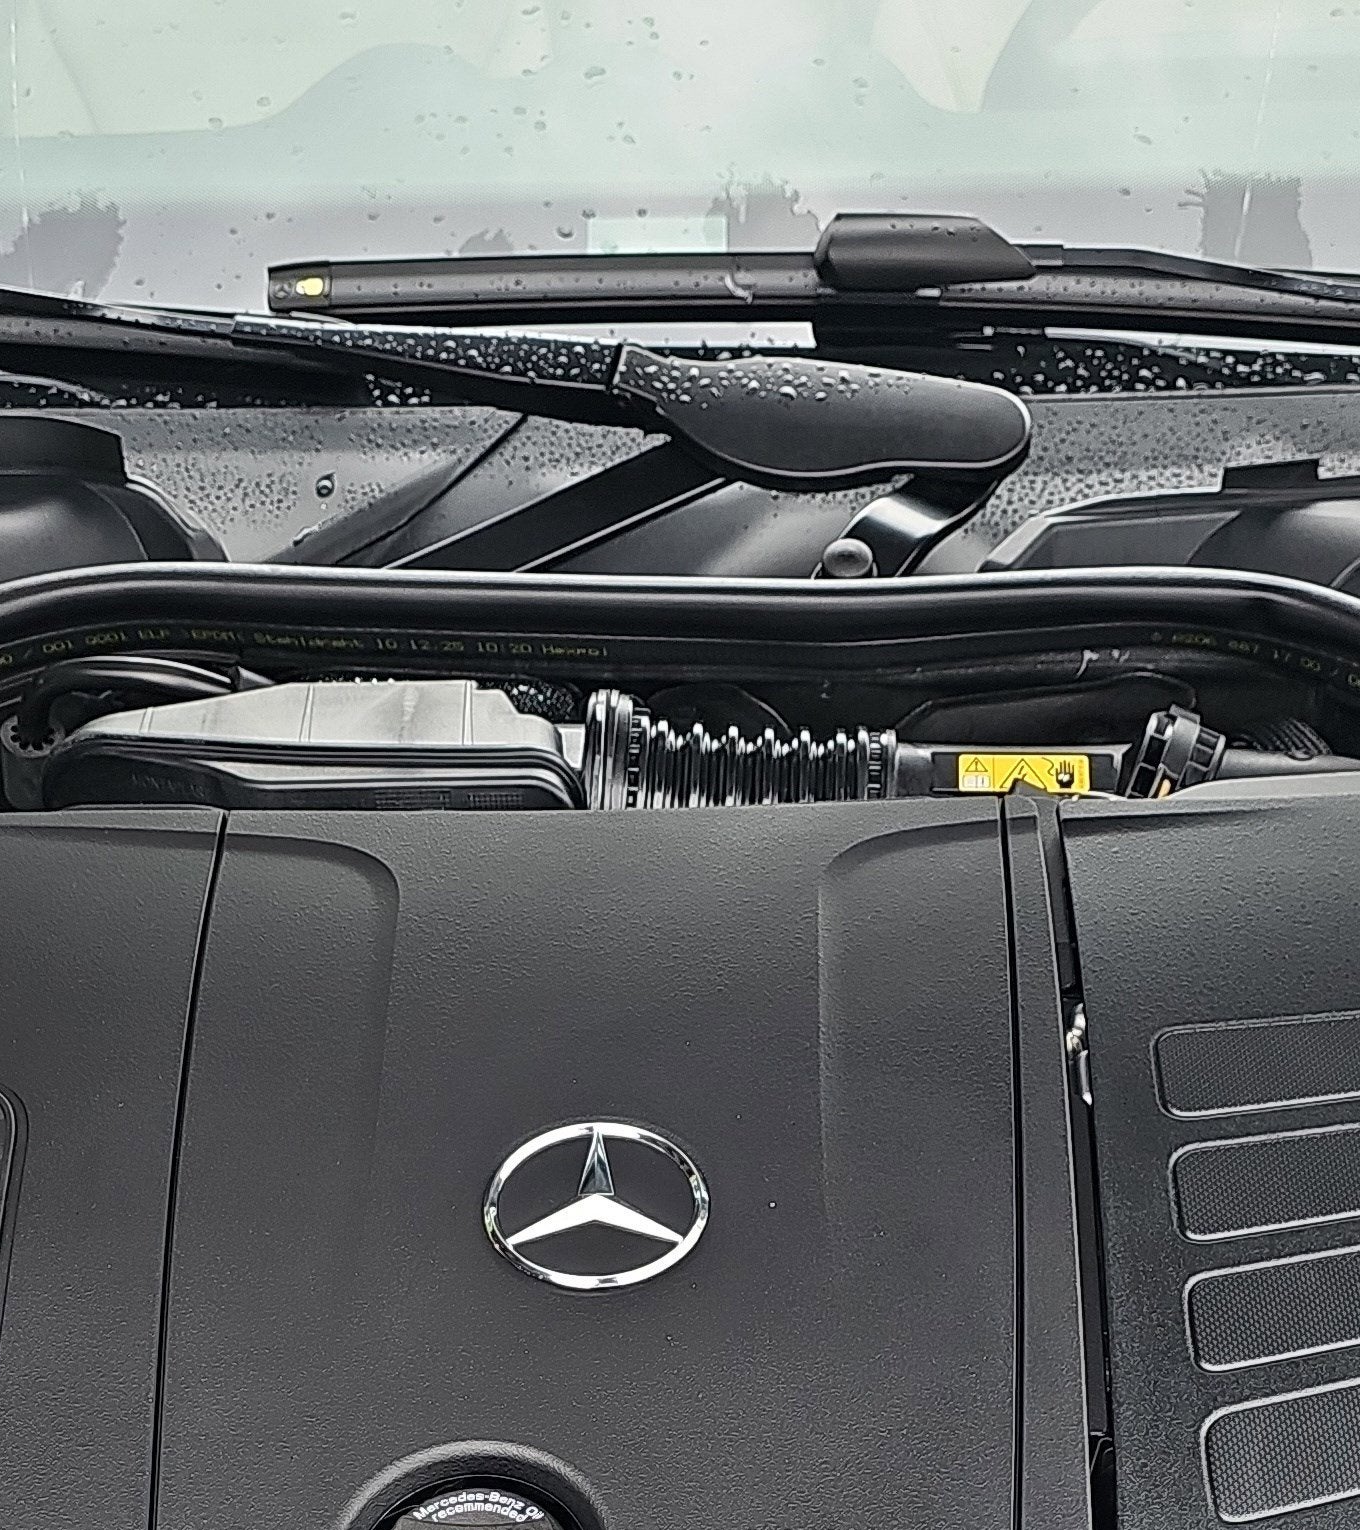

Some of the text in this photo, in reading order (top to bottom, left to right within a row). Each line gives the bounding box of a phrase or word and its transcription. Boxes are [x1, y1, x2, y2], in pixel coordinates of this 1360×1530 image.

[413, 1491, 545, 1521] Mercedes-Benz Oil
[431, 1500, 529, 1522] recommended
